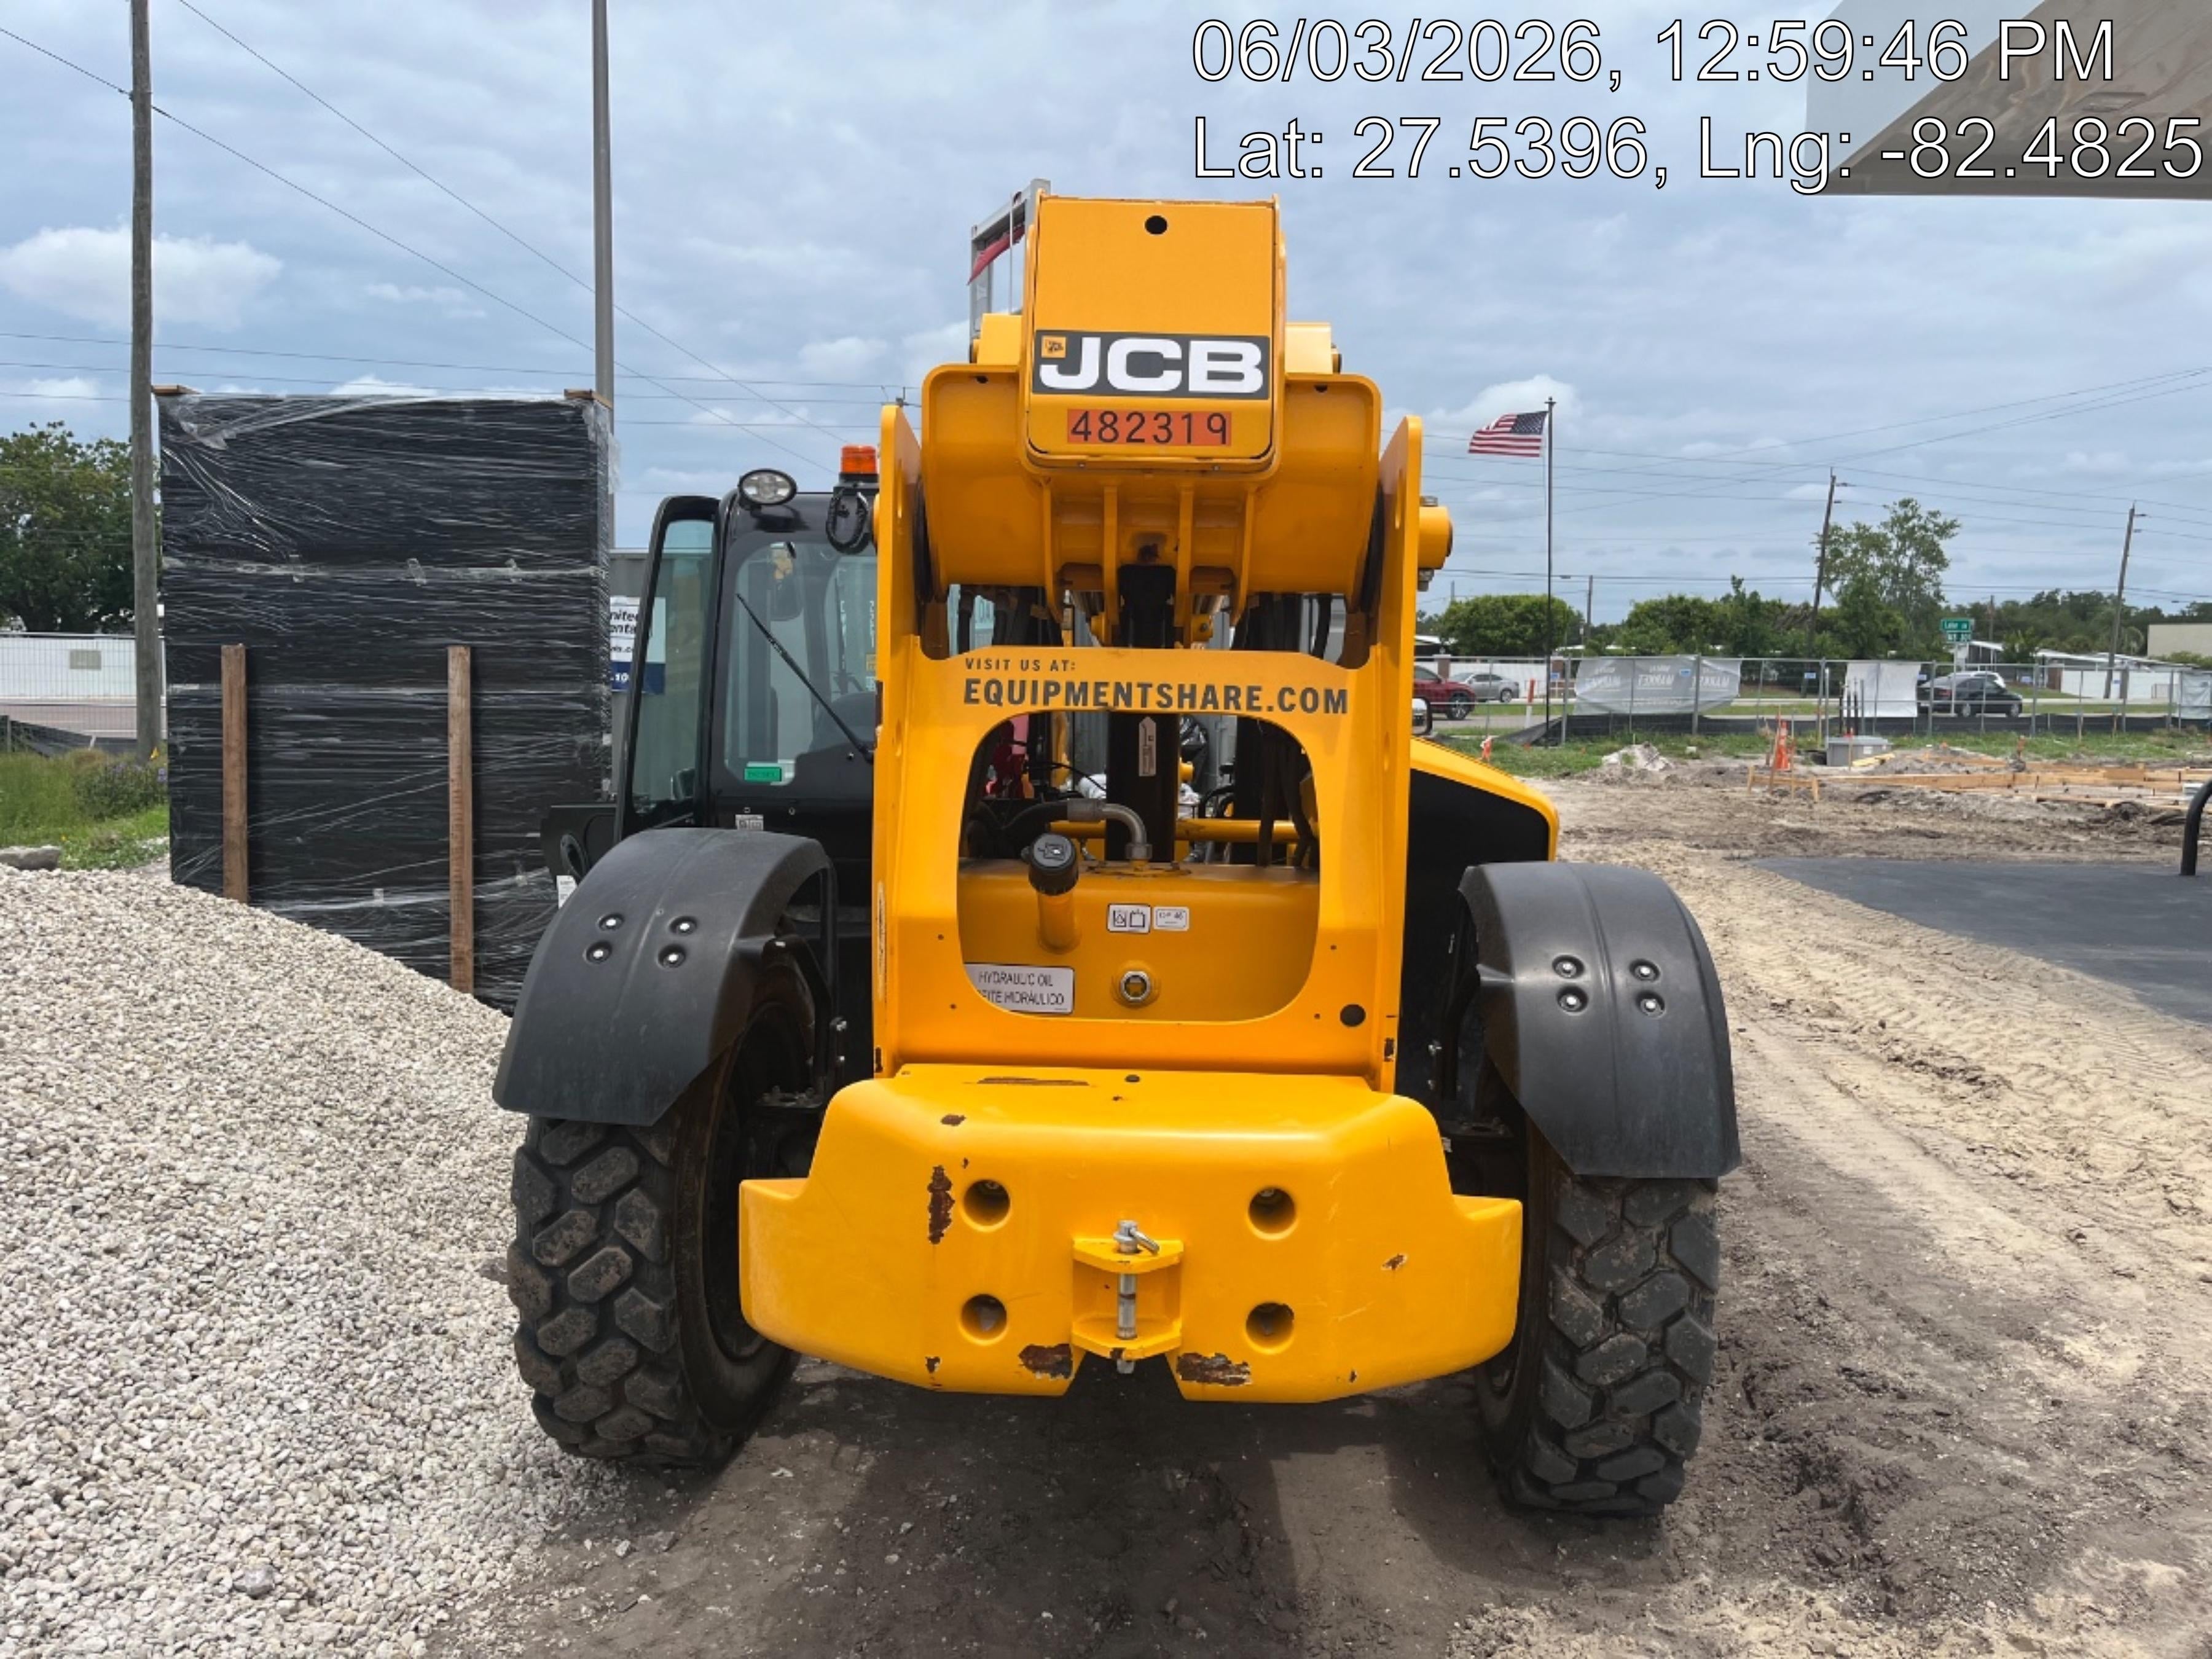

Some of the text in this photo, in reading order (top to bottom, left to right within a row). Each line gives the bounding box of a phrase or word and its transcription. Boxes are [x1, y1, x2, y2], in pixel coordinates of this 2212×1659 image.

[1039, 336, 1264, 393] JCB
[1070, 410, 1228, 444] 482319
[965, 658, 1075, 672] VISIT US AT:
[963, 678, 1348, 714] EQUIPMENTSHARE.COM
[979, 971, 1053, 987] HYDRAULIC OIL
